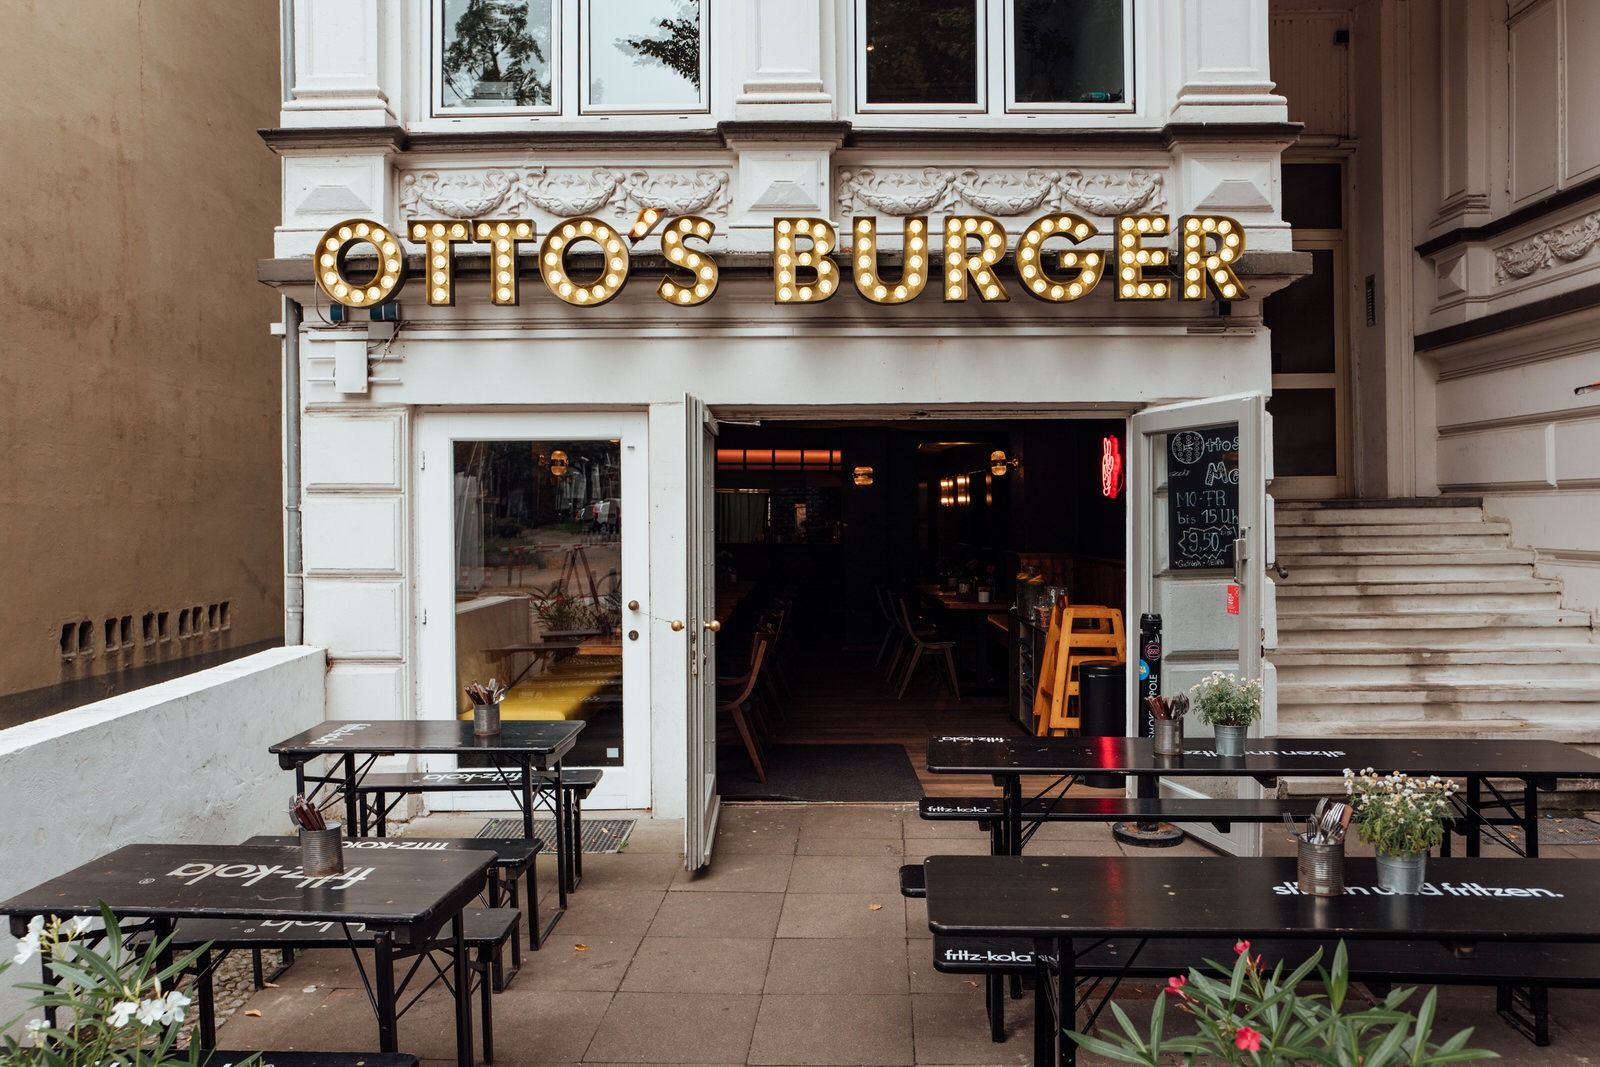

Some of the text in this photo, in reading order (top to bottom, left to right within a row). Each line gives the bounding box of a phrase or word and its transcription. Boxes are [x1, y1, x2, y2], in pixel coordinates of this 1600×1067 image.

[773, 212, 1249, 305] BURGER
[1177, 508, 1239, 524] bis 15 Uh
[1188, 531, 1220, 552] 9,50
[1149, 674, 1158, 696] POLE
[927, 805, 988, 813] fritz-kola
[1371, 882, 1444, 896] ud
[1442, 881, 1564, 898] fritzen.
[944, 949, 1032, 962] fritz-kola
